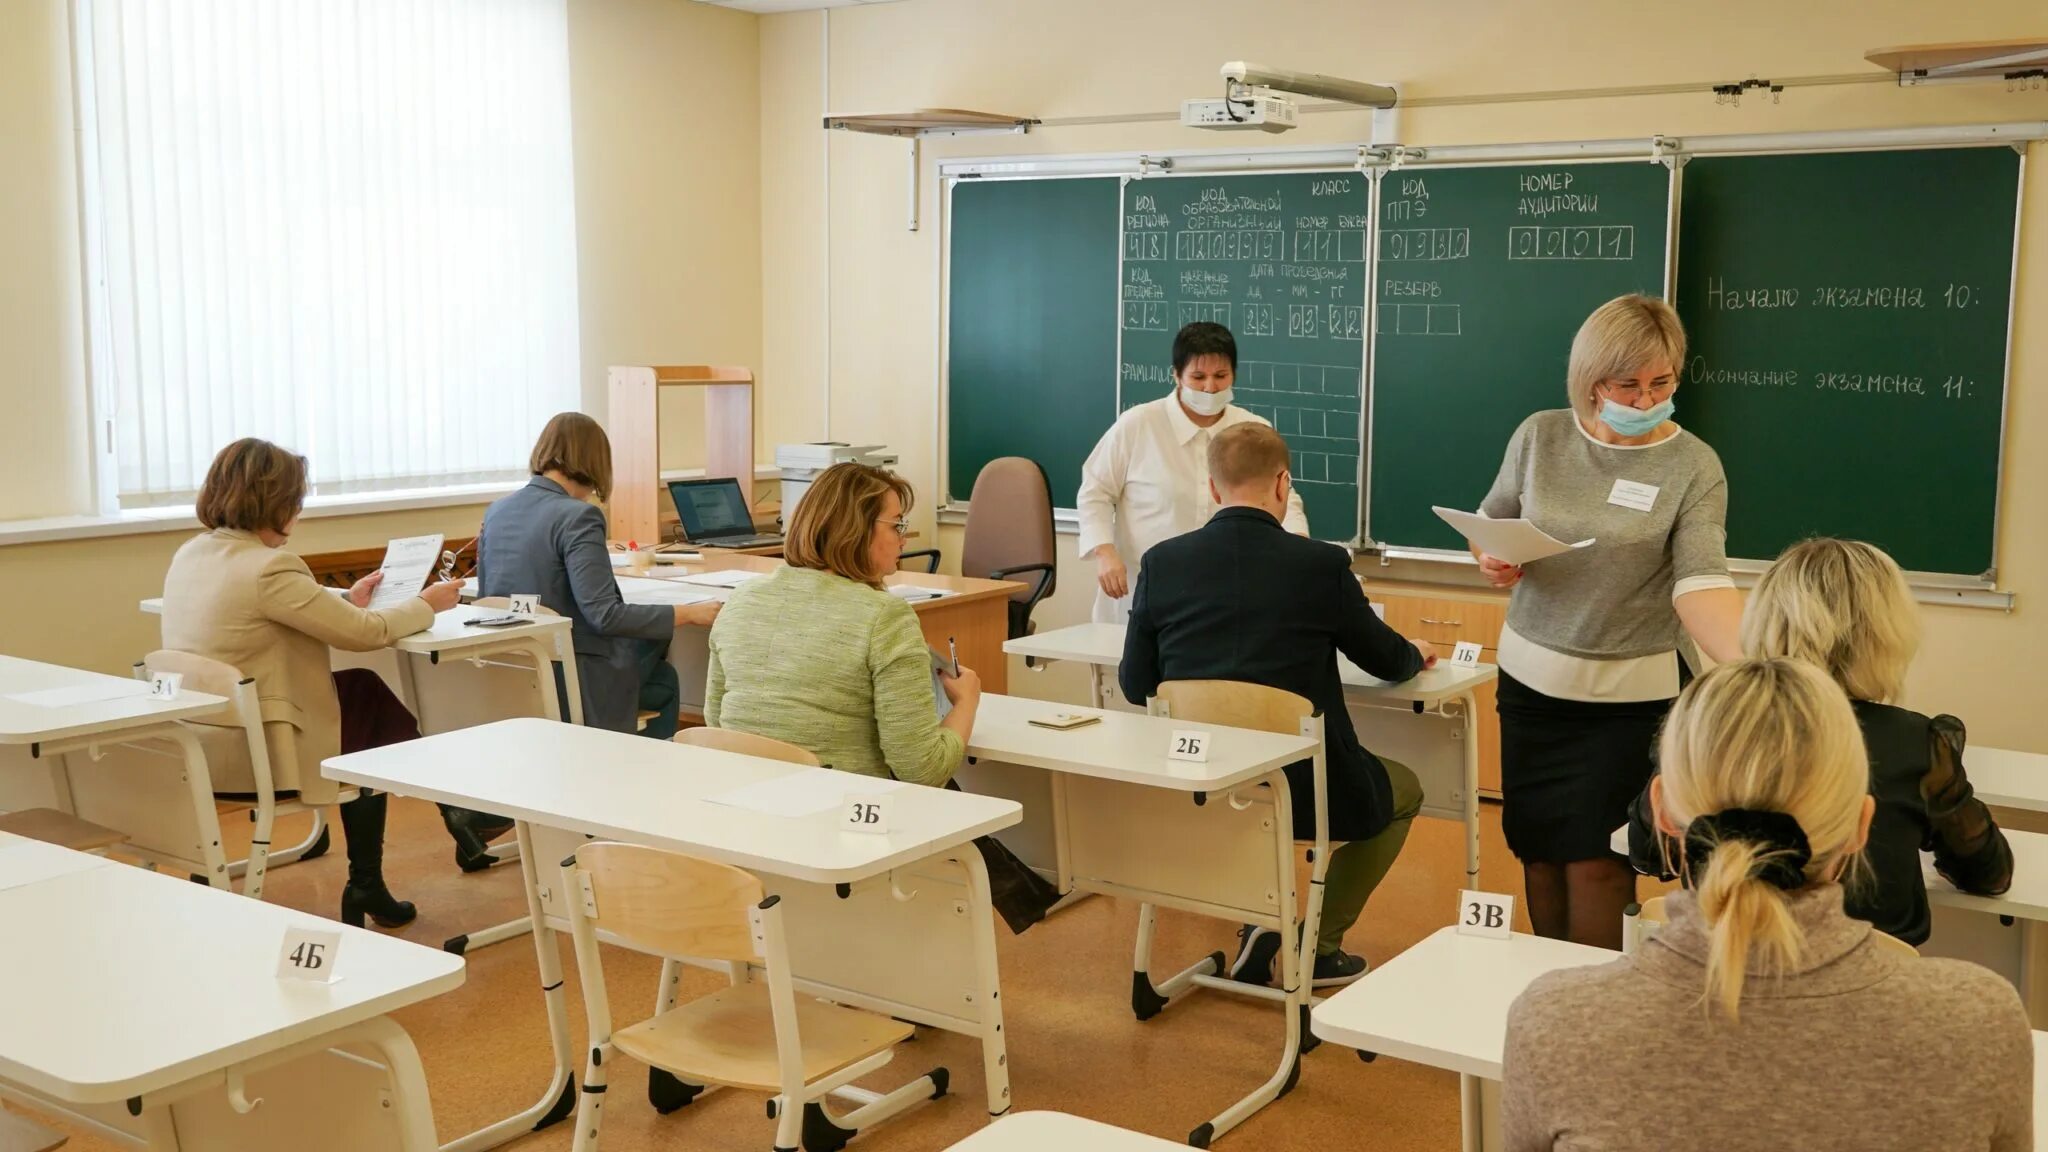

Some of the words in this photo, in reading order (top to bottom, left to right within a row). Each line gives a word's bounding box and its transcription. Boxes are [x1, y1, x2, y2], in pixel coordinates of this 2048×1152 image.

[1312, 179, 1351, 196] КЛАСС
[1402, 178, 1429, 200] КОД
[1520, 173, 1574, 193] НОМЕР
[1135, 195, 1156, 213] КОД
[1201, 186, 1228, 203] КОД
[1388, 200, 1428, 222] ППЭ
[1517, 194, 1600, 218] АУДИТОРИИ
[1126, 213, 1170, 230] РЕГИОНА
[1130, 266, 1153, 286] КОД
[1248, 263, 1274, 280] ДАТА
[1385, 279, 1442, 298] РЕЗЕРВ
[1708, 275, 1799, 311] Начало
[1812, 285, 1926, 309] экзамена
[1944, 283, 1981, 309] 10:
[1690, 355, 1800, 387] Окончание
[1814, 371, 1927, 396] экзамена
[1942, 375, 1975, 399] 11:
[511, 600, 531, 614] 2А
[1458, 649, 1474, 662] 1Б
[1176, 737, 1201, 755] 2Б
[849, 803, 880, 824] 3Б
[1465, 902, 1504, 928] 3В
[289, 941, 325, 969] 4Б
